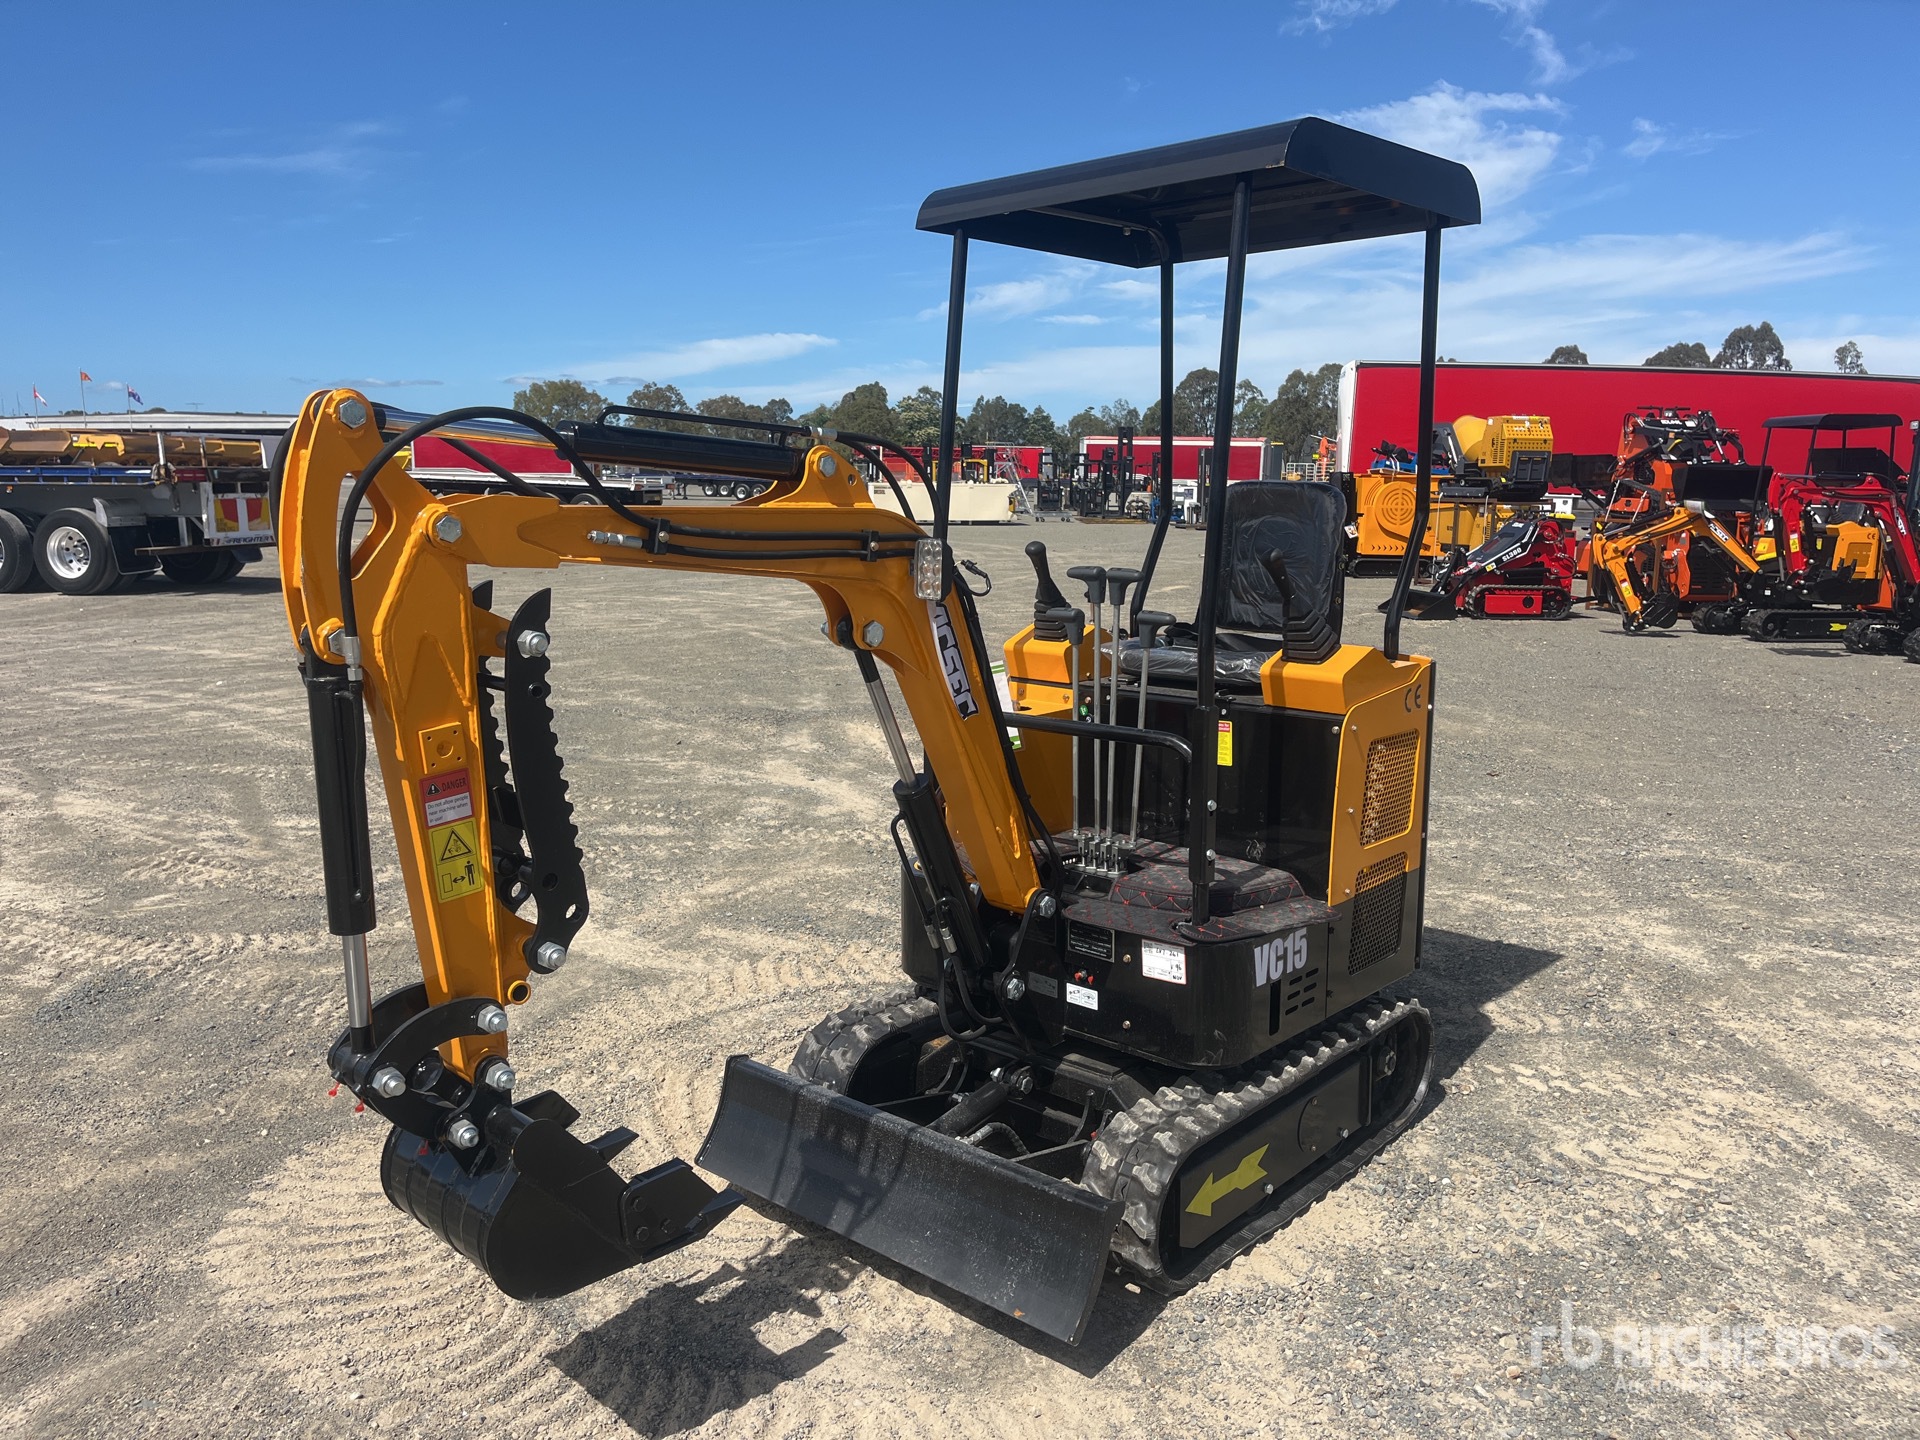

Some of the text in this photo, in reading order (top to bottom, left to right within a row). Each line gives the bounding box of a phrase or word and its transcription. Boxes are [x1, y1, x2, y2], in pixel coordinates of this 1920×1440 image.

[1502, 547, 1522, 561] SL380
[1405, 684, 1422, 713] CE
[442, 777, 467, 792] DANGER
[454, 795, 469, 803] people
[1254, 927, 1308, 987] VC15
